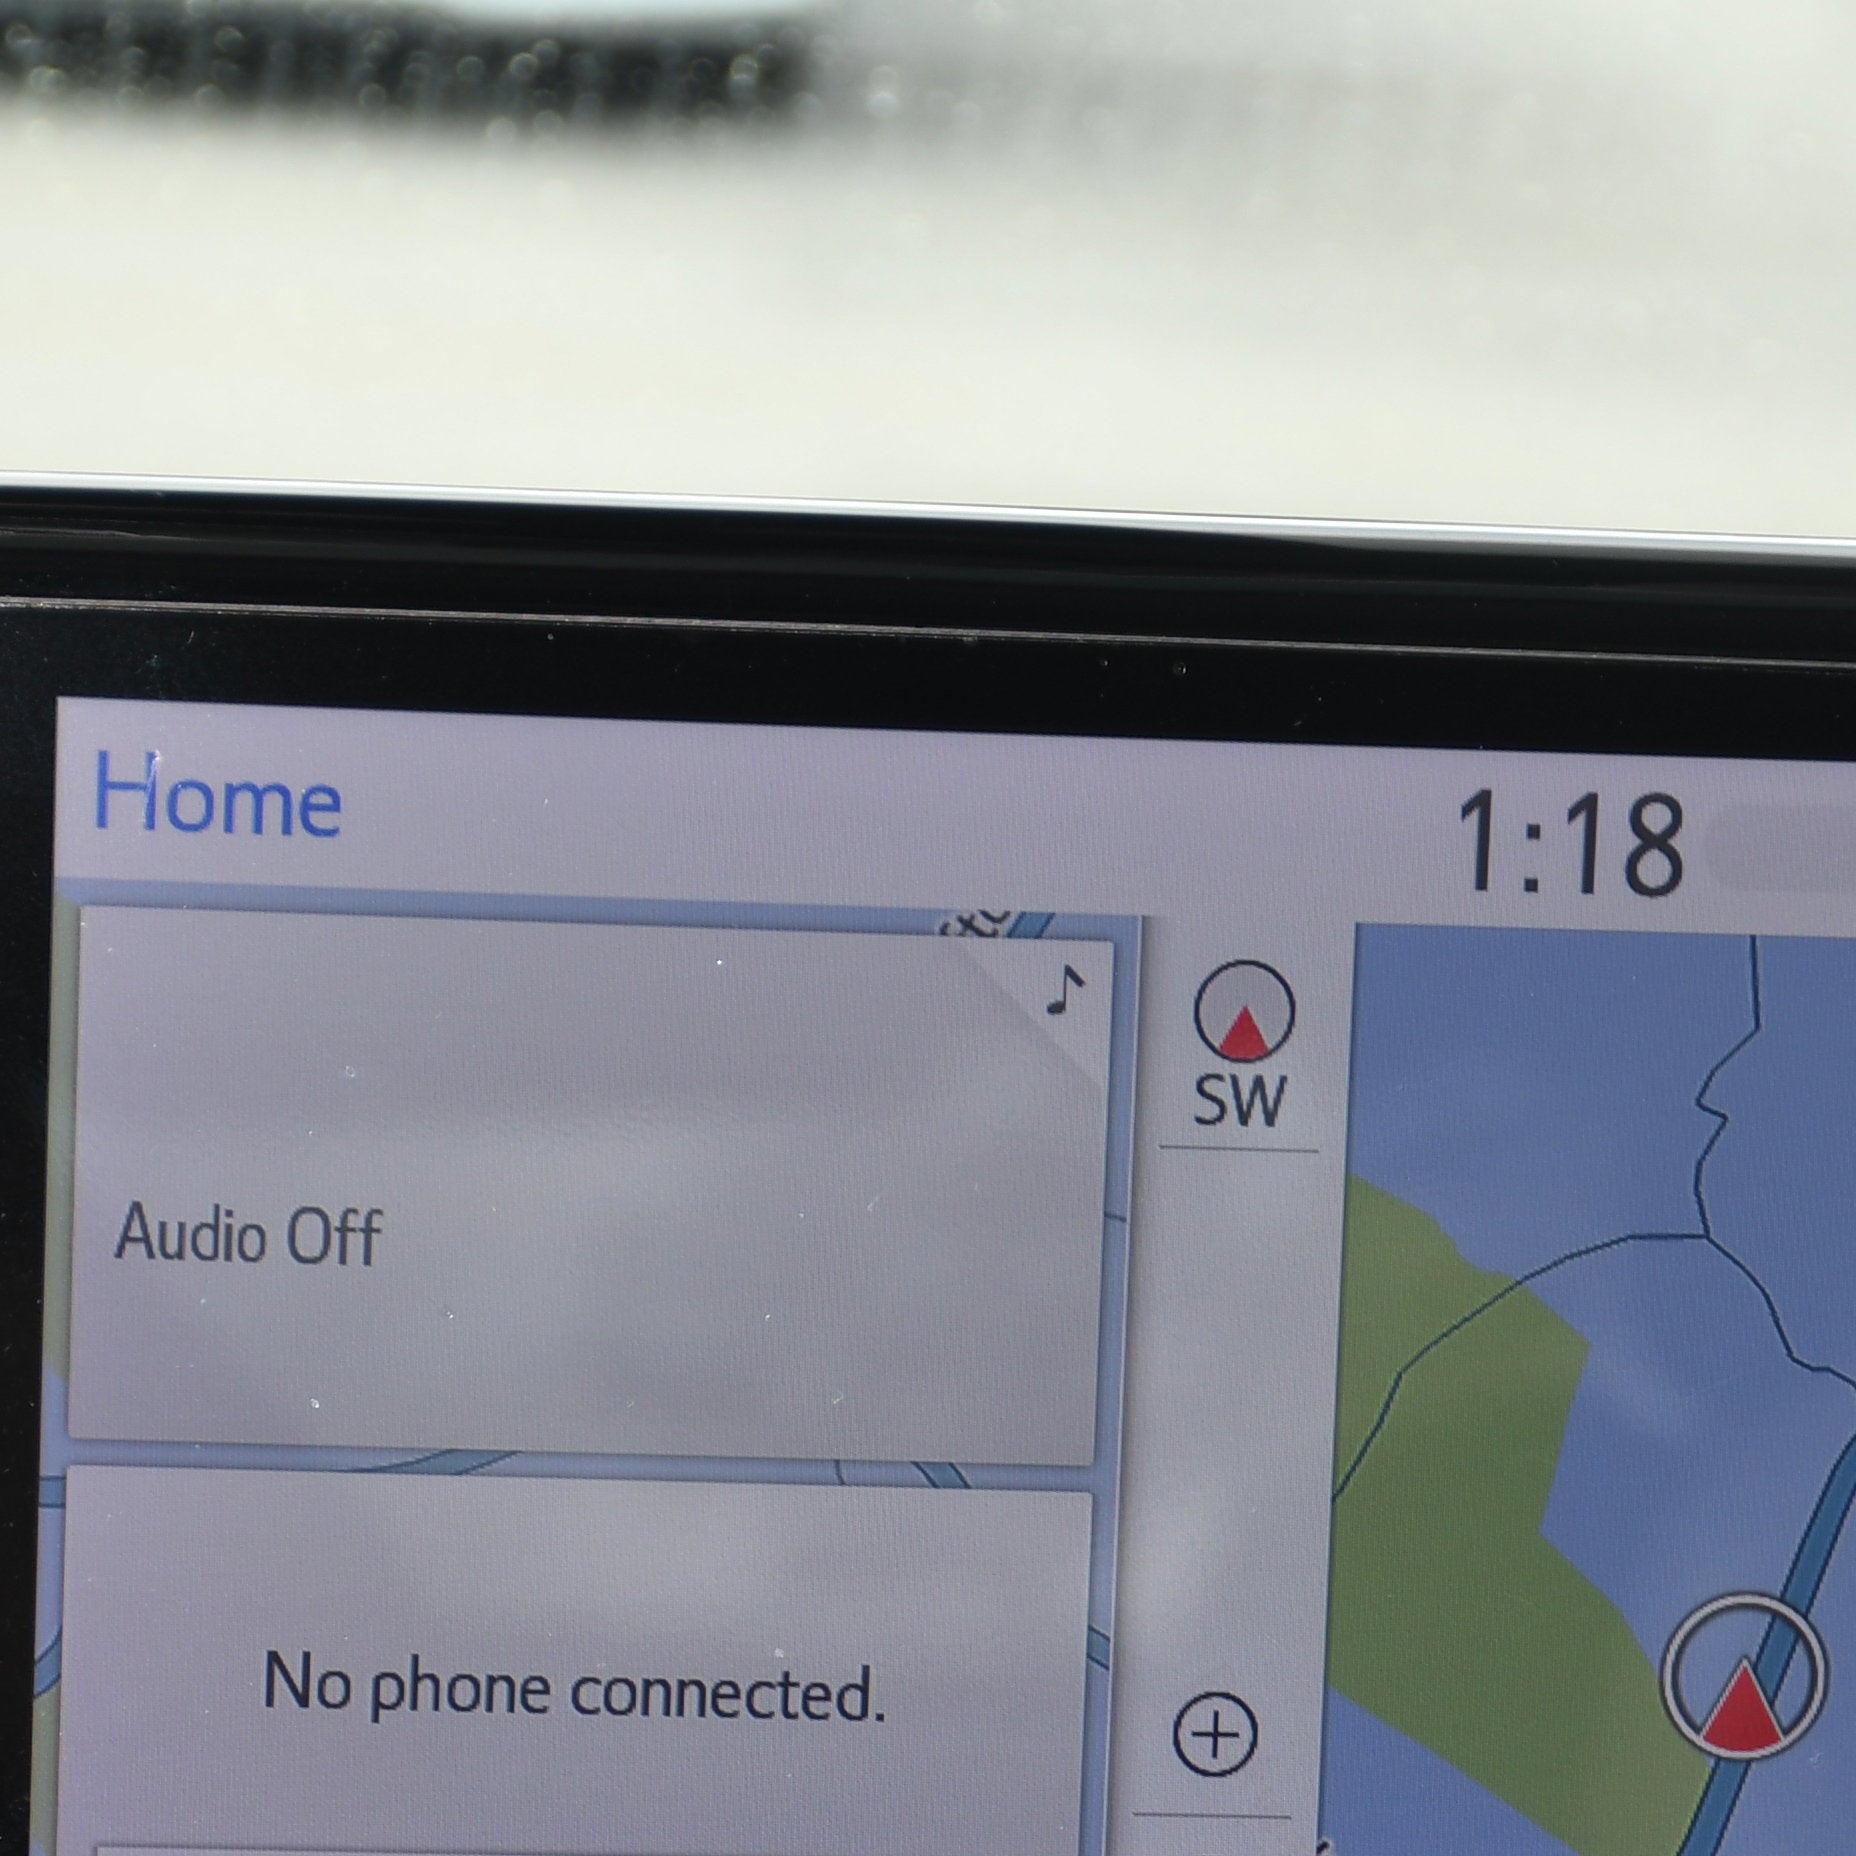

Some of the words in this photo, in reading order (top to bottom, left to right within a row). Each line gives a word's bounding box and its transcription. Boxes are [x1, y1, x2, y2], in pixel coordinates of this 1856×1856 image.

[94, 748, 343, 840] Home
[1462, 789, 1682, 898] 1:18
[1195, 1073, 1287, 1127] SW
[114, 1201, 266, 1262] Audio
[289, 1207, 383, 1266] Off
[266, 1651, 351, 1709] No
[372, 1654, 550, 1723] phone
[572, 1665, 884, 1722] connected.
